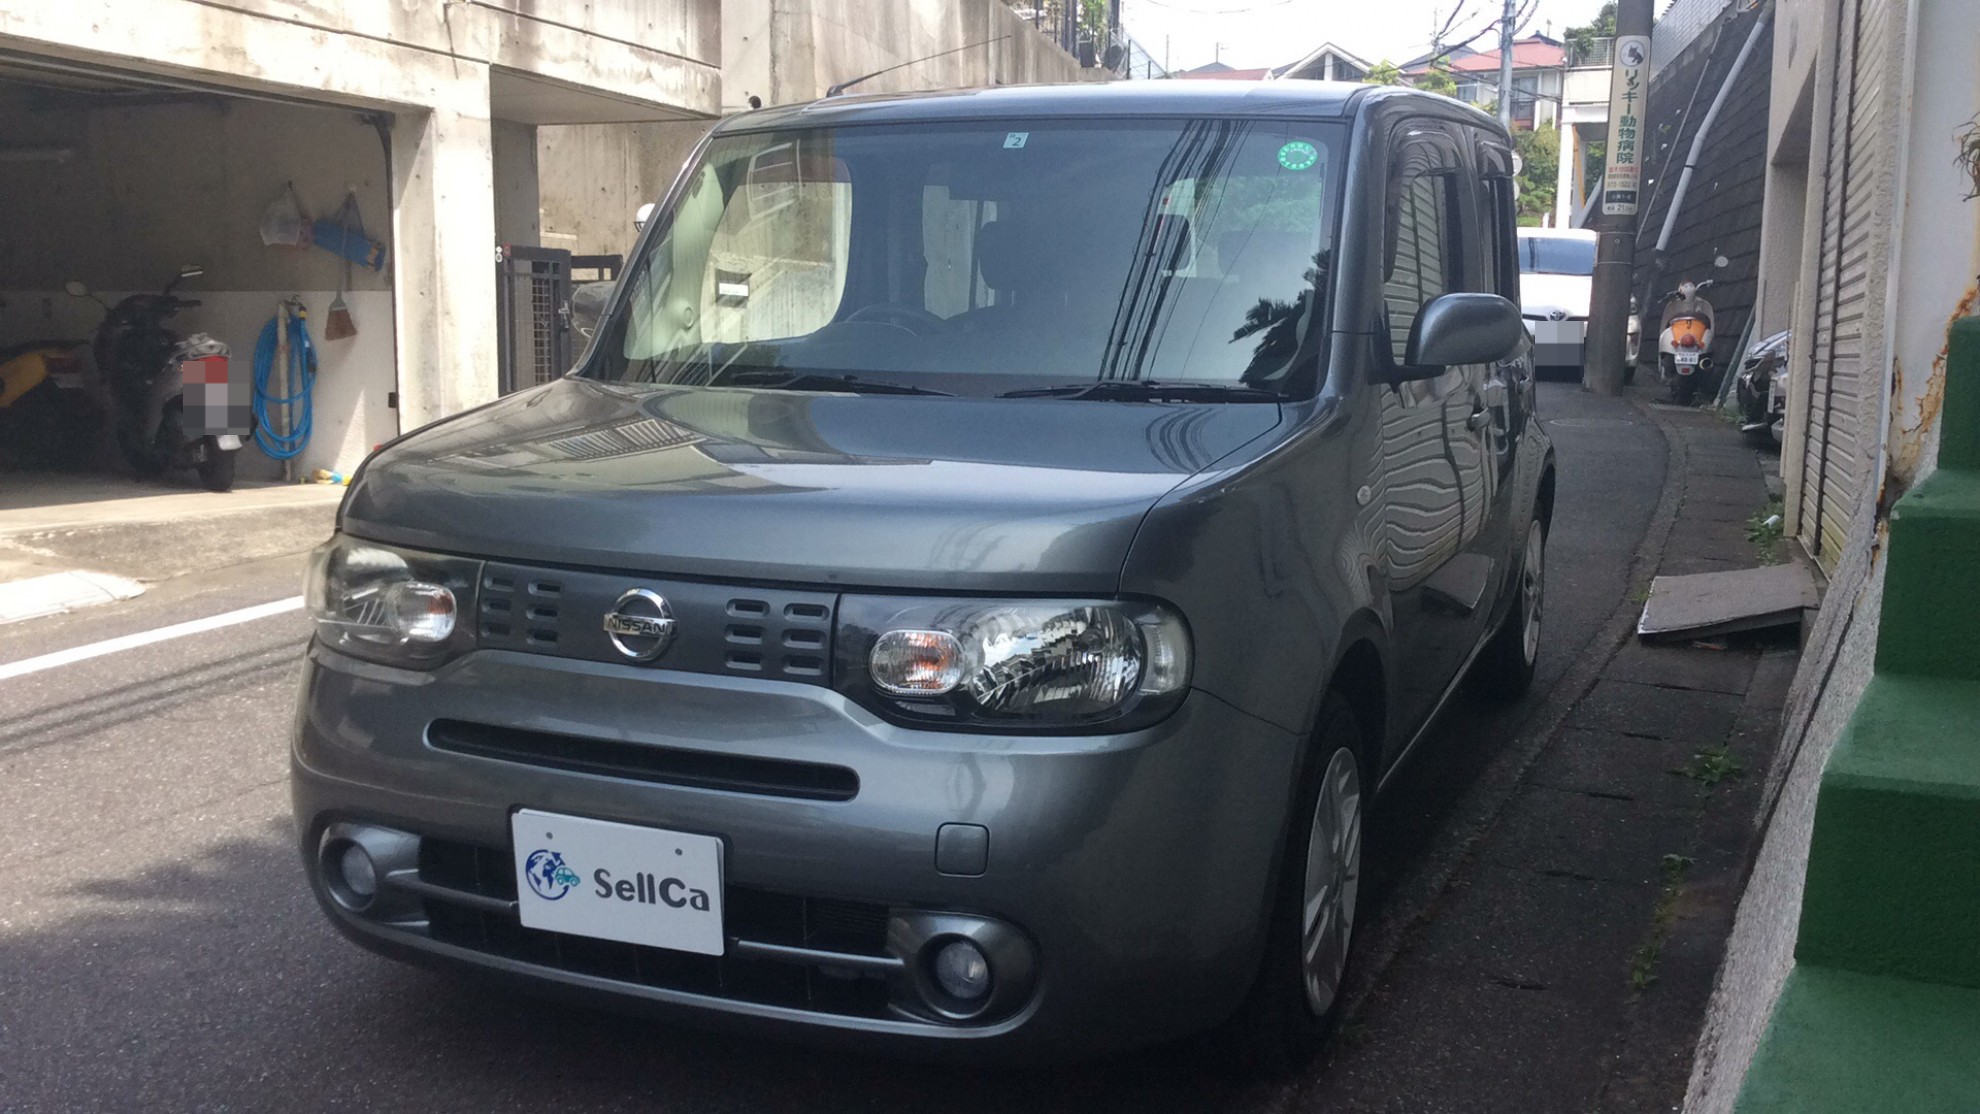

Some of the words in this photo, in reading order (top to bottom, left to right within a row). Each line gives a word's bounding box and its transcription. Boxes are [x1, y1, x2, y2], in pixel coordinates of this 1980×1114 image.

[1616, 69, 1640, 165] リッキー動物病院
[1012, 137, 1021, 146] 2
[607, 617, 667, 633] NISSAN
[593, 868, 710, 912] SellCa
